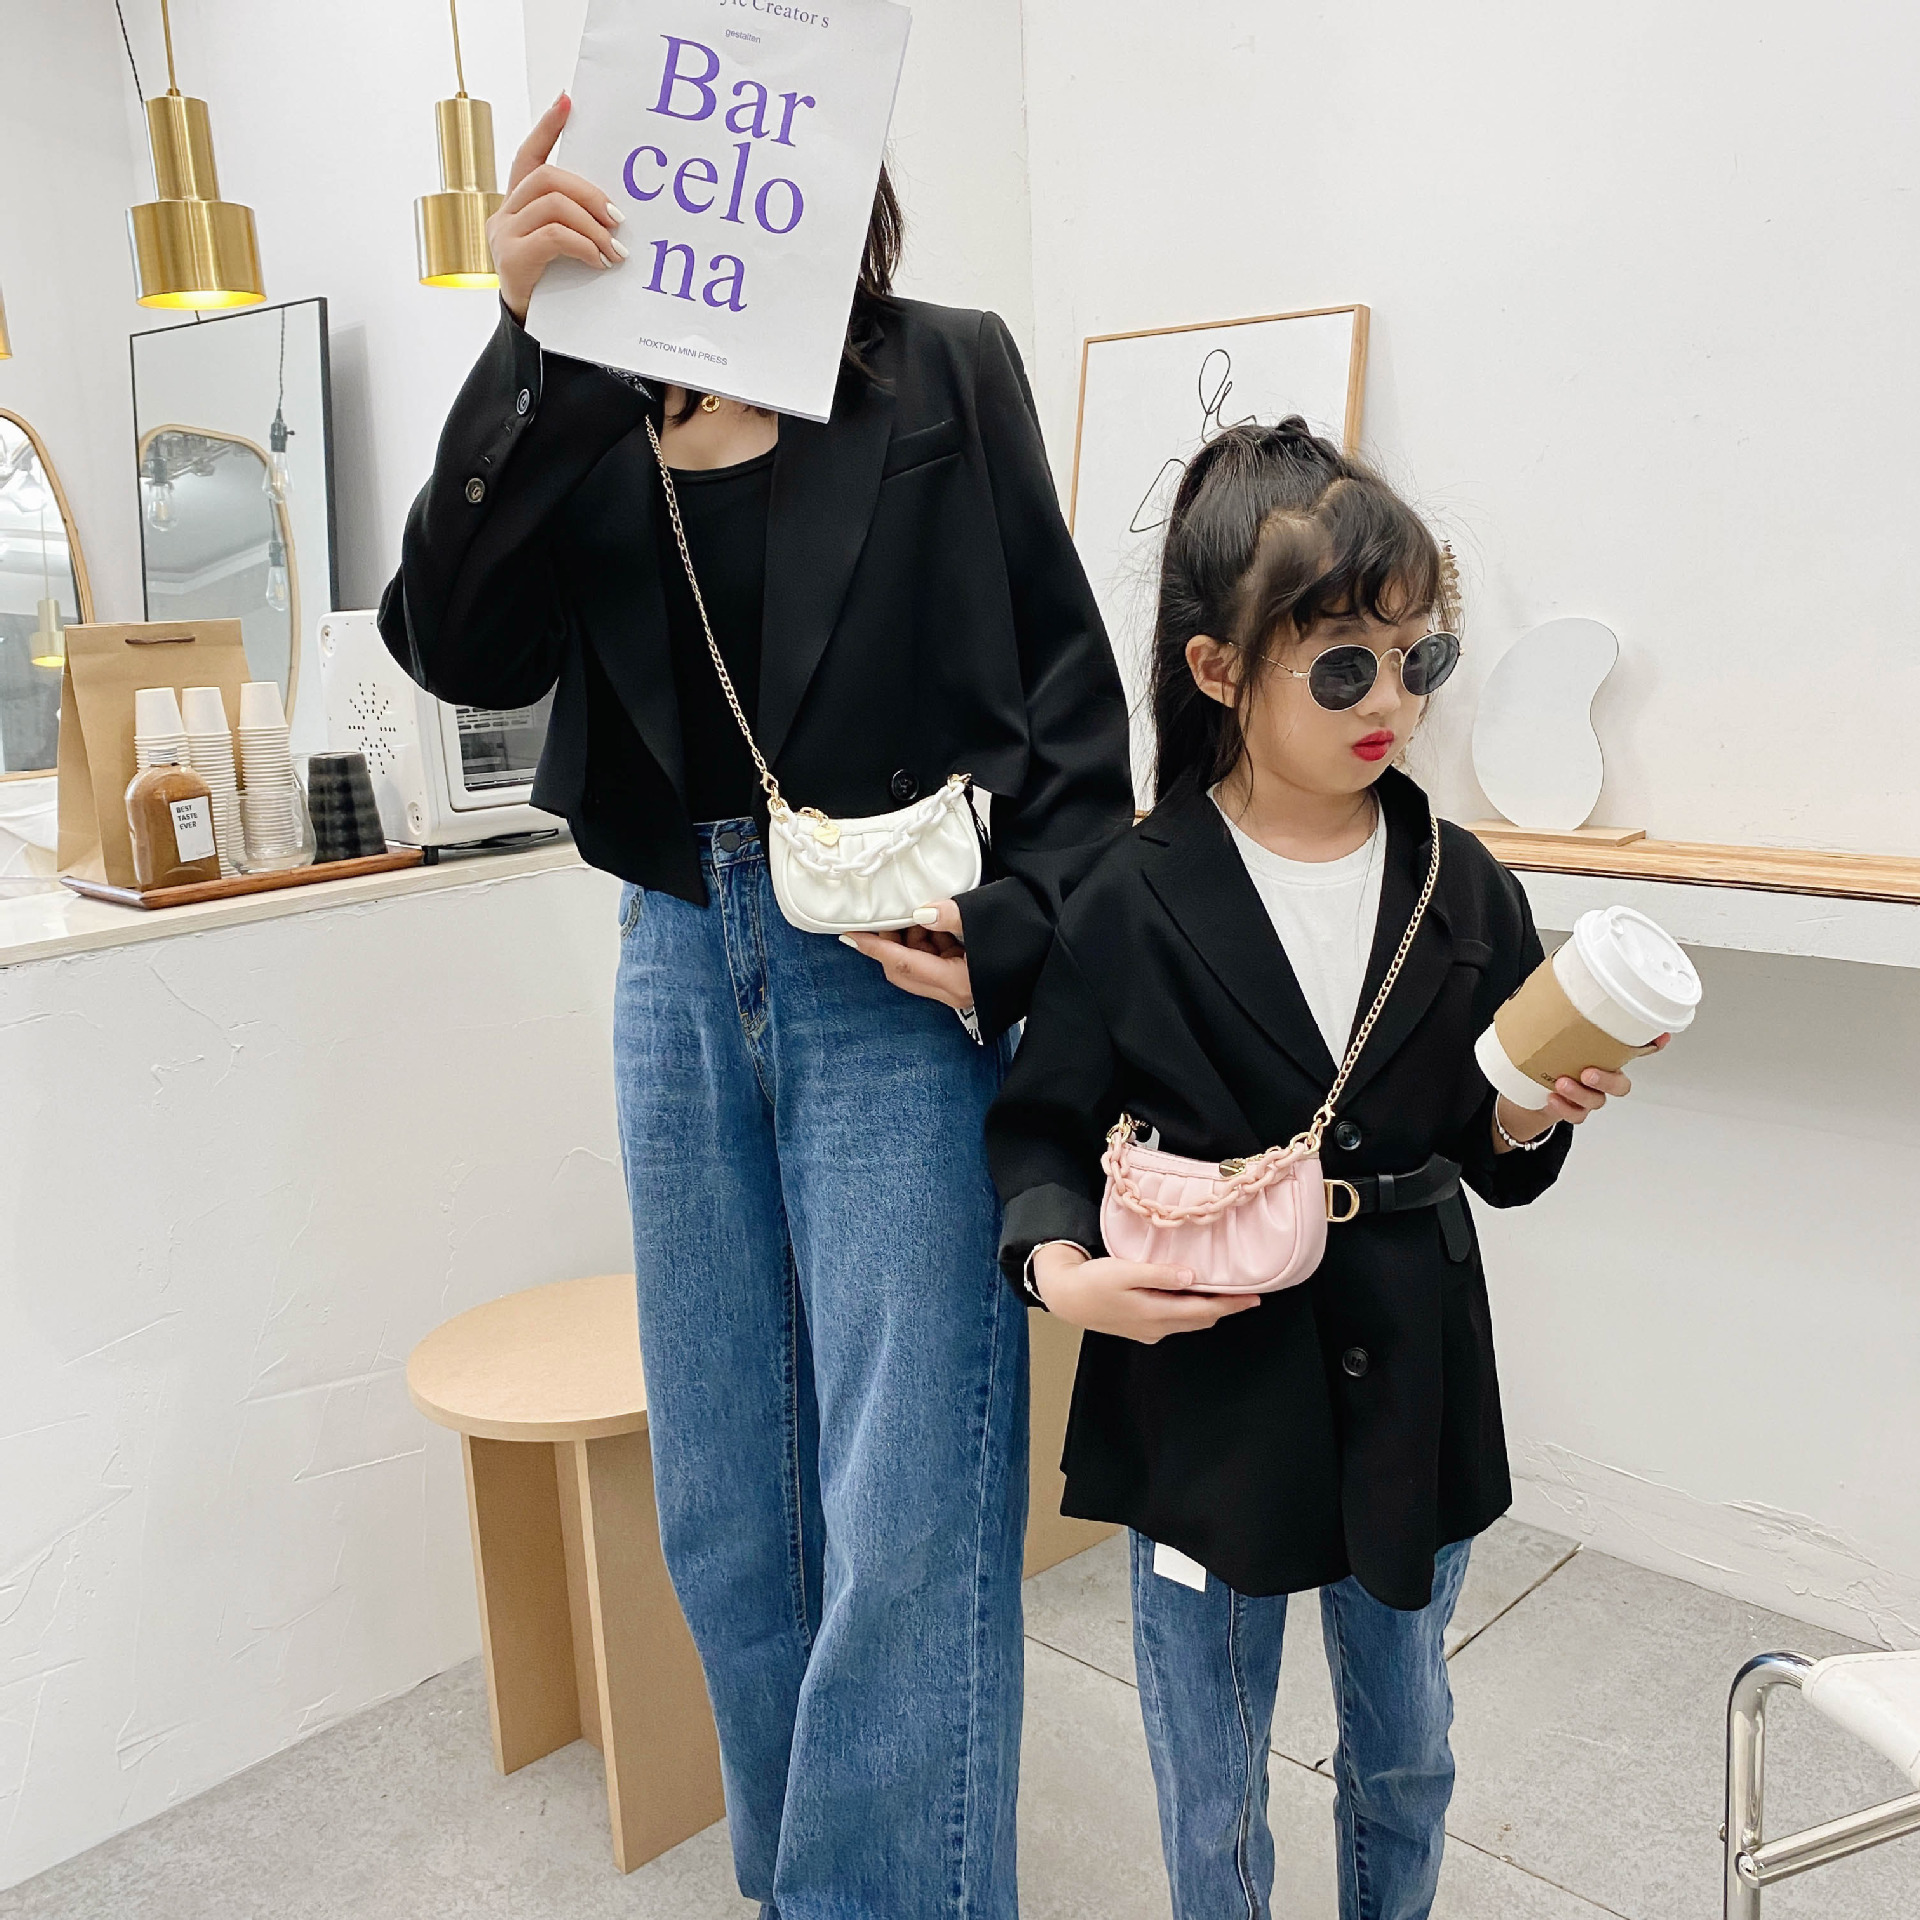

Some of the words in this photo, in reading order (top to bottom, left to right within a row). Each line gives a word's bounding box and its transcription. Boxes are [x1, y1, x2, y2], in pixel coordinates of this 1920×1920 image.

[725, 29, 761, 44] gestalten
[646, 34, 816, 147] Bar
[622, 141, 804, 234] celo
[641, 239, 748, 312] na
[638, 337, 677, 353] HOXTON
[678, 347, 697, 358] MINI
[698, 352, 728, 365] PRESS
[176, 805, 192, 813] BEST
[177, 813, 198, 821] TASTE
[180, 821, 197, 830] EVER
